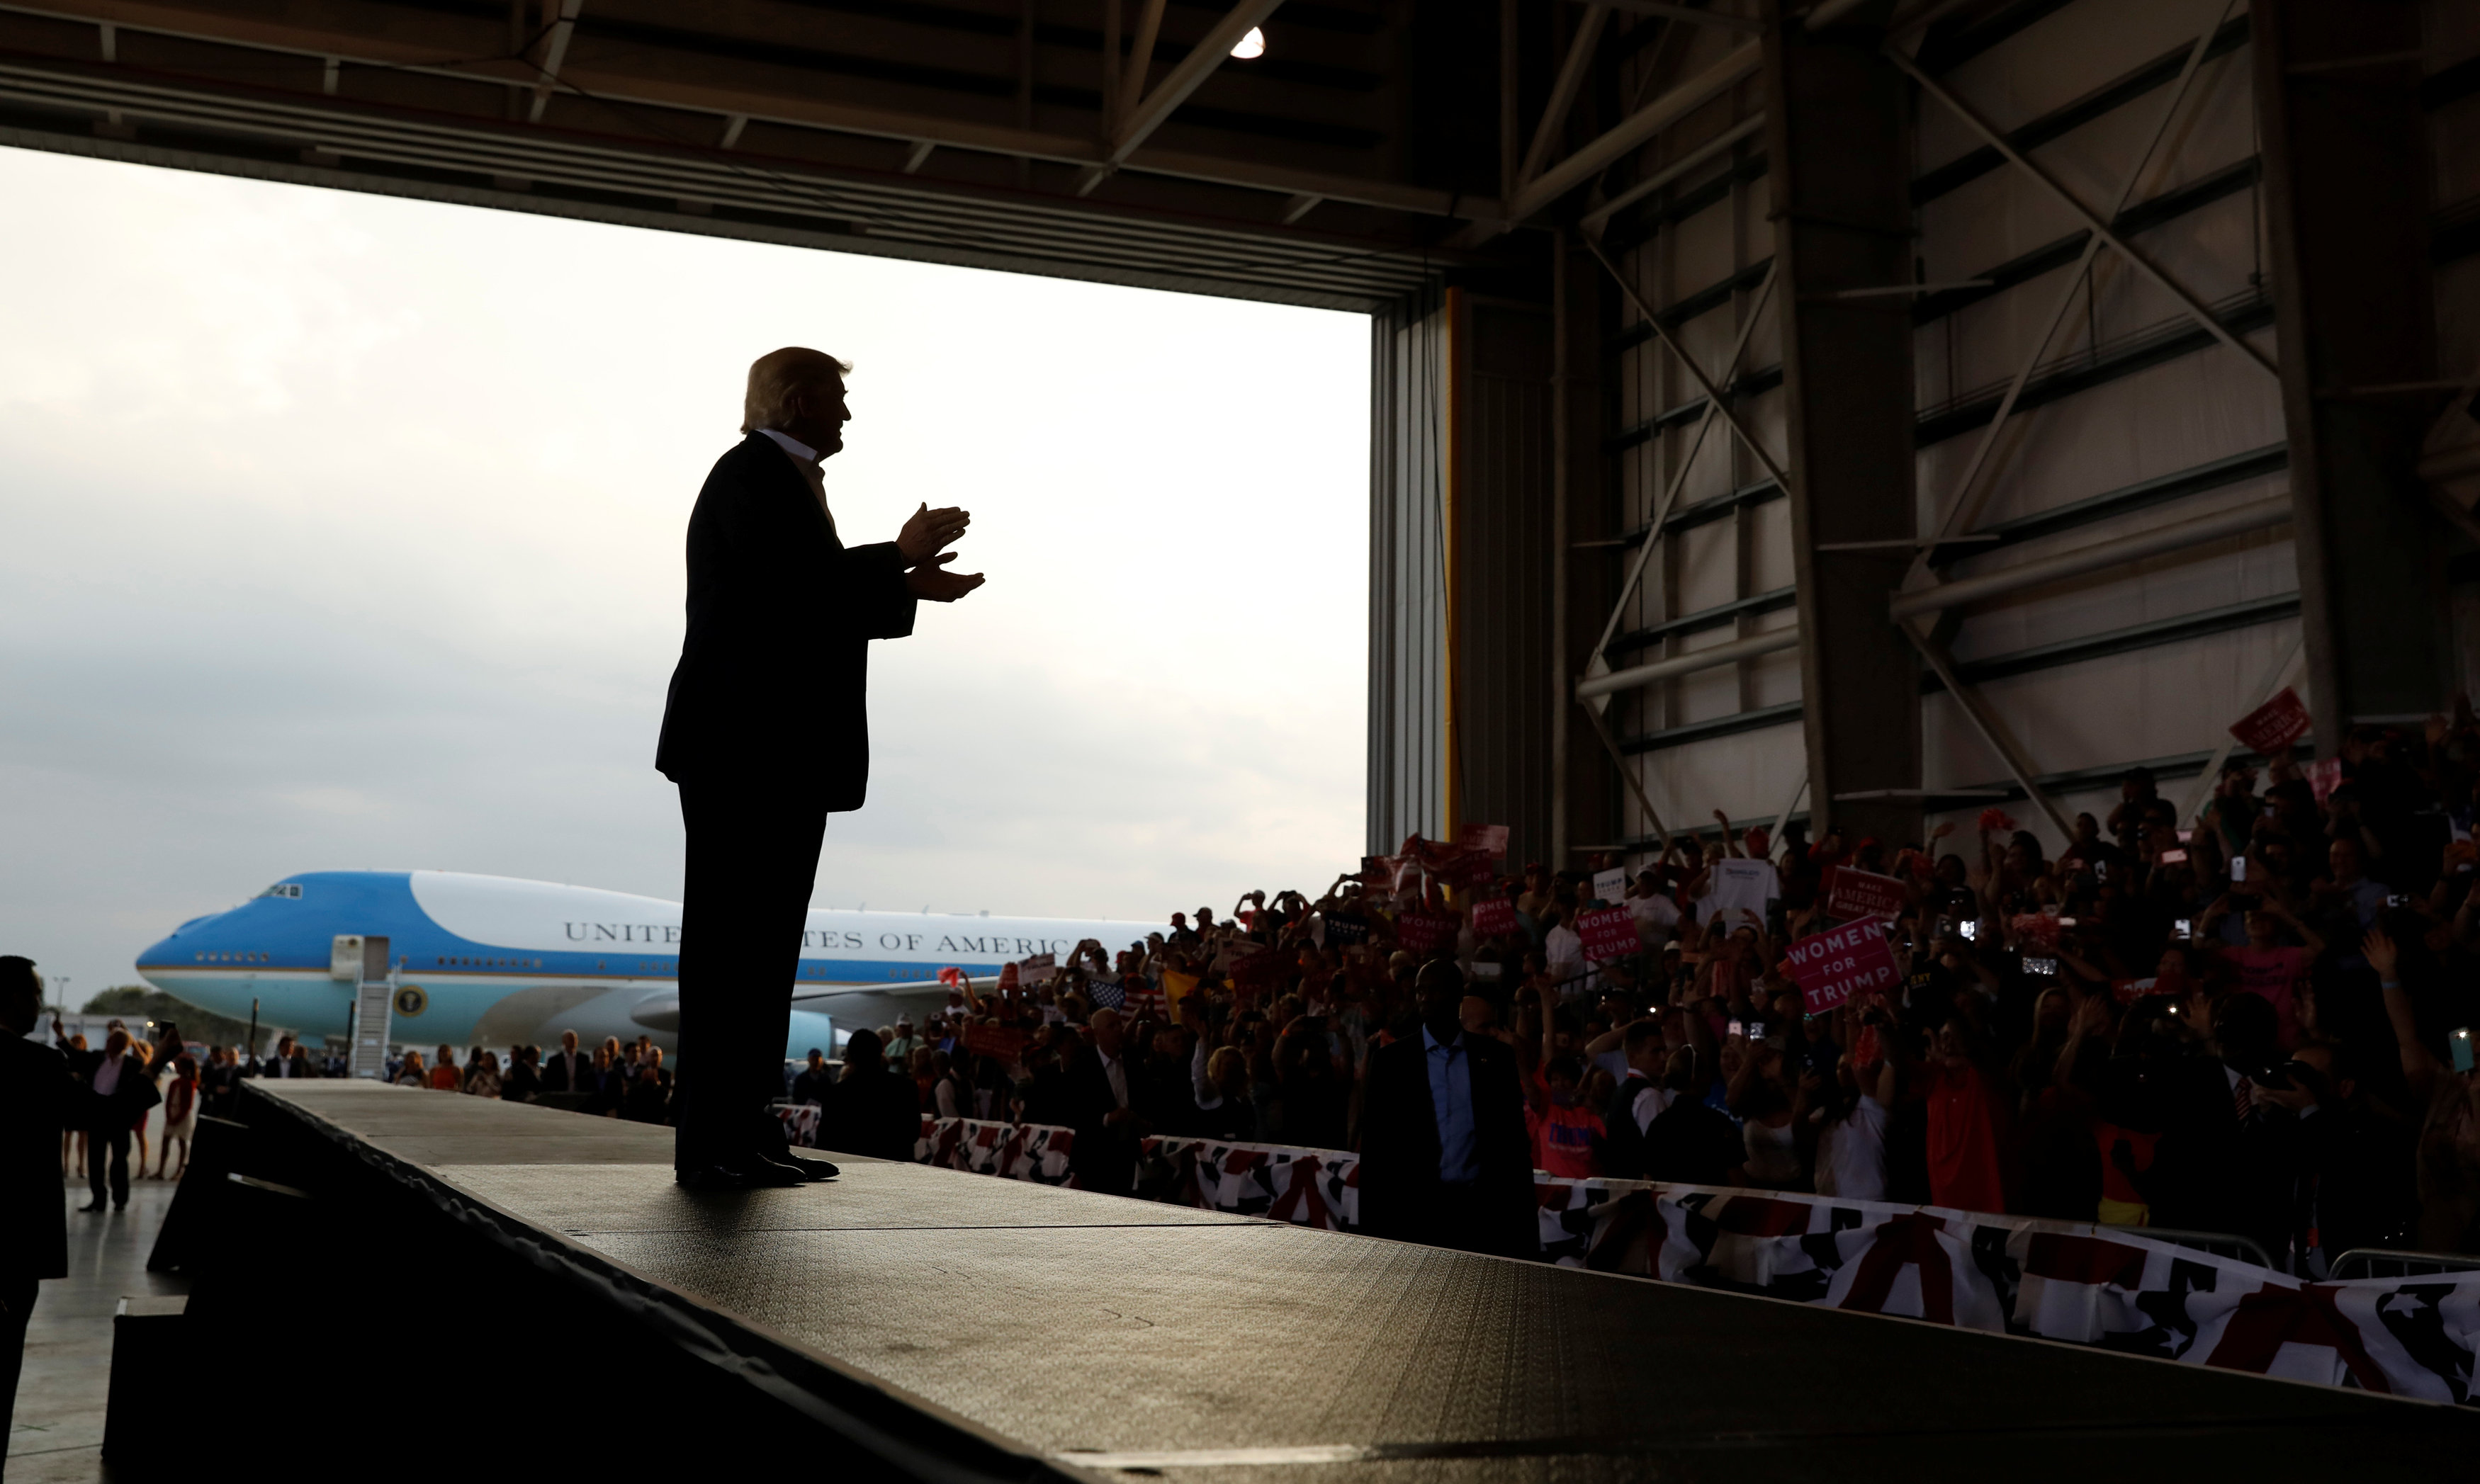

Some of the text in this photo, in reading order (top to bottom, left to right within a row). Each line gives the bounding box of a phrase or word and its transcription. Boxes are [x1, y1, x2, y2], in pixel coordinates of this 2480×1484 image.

[1476, 899, 1512, 913] OMEN
[1834, 887, 1903, 912] AMERICA
[1329, 919, 1367, 931] TRUMP
[1400, 914, 1457, 930] WOMEN
[1577, 910, 1633, 929] WOMEN
[565, 922, 1070, 956] UNITE TES OF AMERIC
[1416, 930, 1438, 941] FOR
[1596, 929, 1617, 939] FOR
[1788, 922, 1882, 965] WOMEN
[1585, 937, 1636, 958] TRUMP
[1822, 956, 1856, 976] FOR
[1808, 965, 1890, 1006] TRUMP
